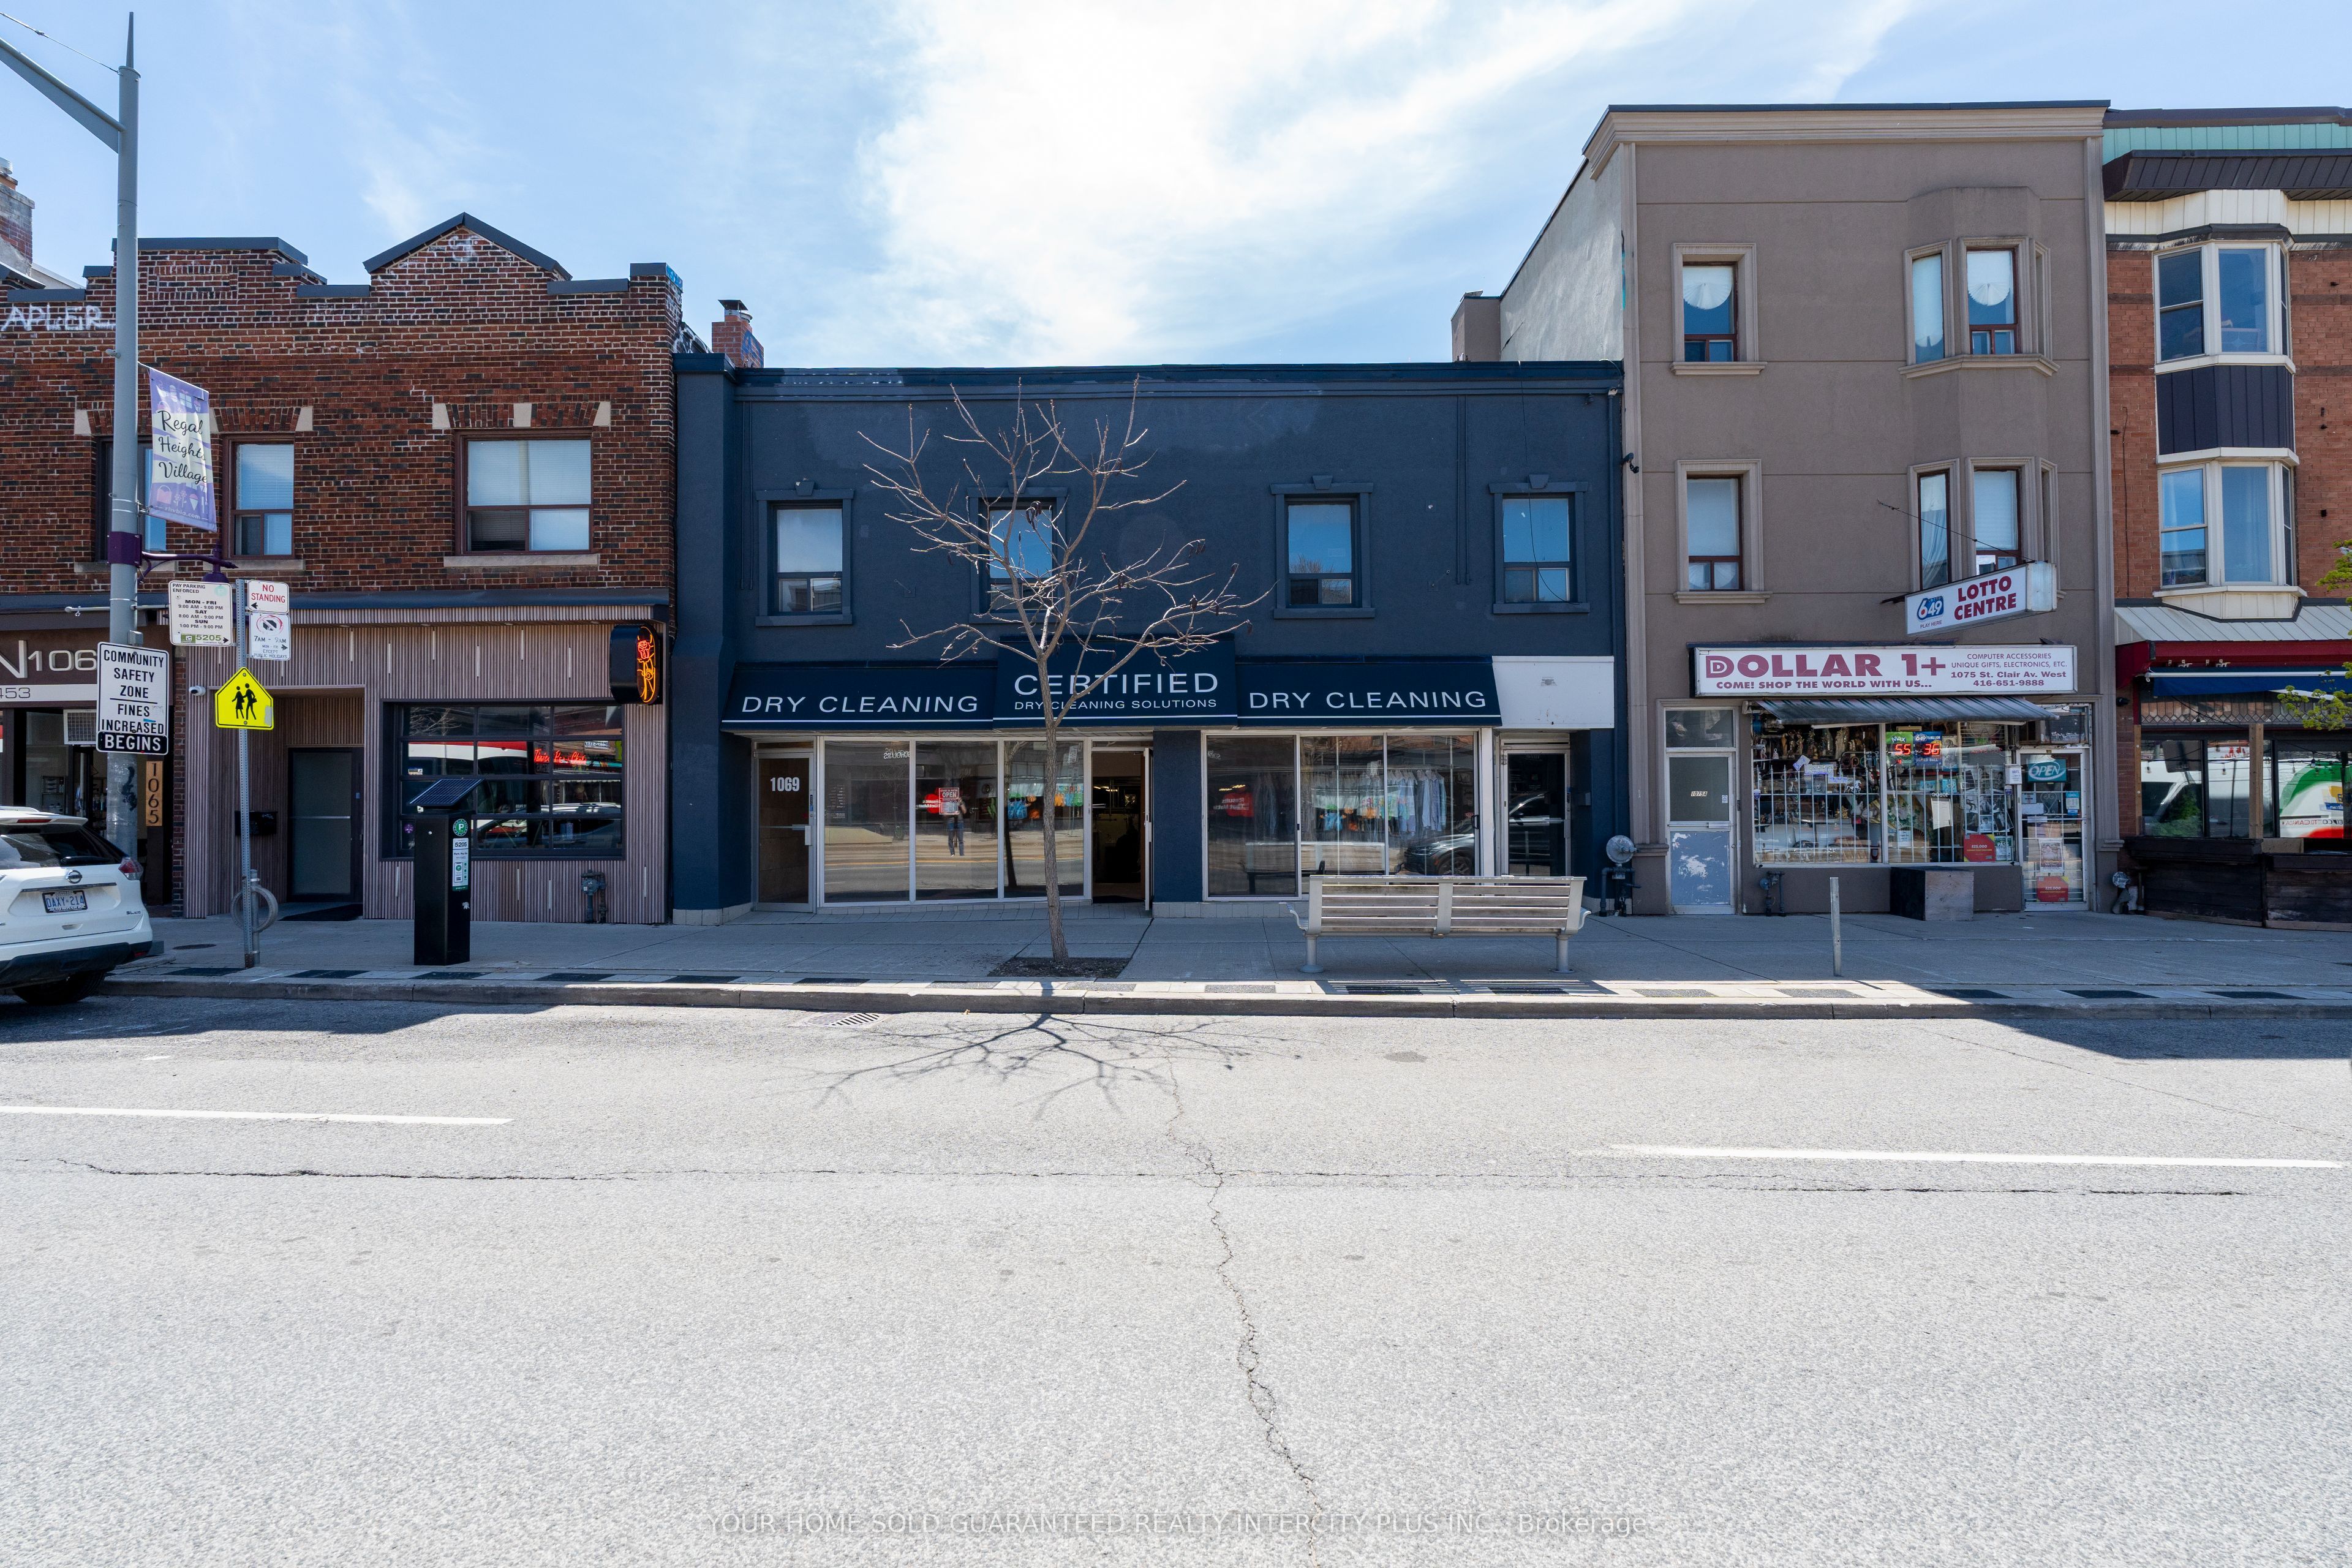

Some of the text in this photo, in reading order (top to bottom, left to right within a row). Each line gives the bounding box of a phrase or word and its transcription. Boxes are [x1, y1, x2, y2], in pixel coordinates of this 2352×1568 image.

[157, 410, 203, 435] Regal
[159, 436, 206, 461] Heights
[159, 461, 208, 484] Village
[251, 593, 285, 603] STANDING
[1958, 576, 2011, 602] LOTTO
[1918, 600, 1943, 619] 649
[1954, 593, 2016, 620] CENTRE
[104, 649, 164, 668] COMMUNITY
[1706, 654, 1946, 678] DOLLAR 1+
[114, 668, 155, 682] SAFETY
[1014, 673, 1218, 695] CERTIFIED
[120, 685, 149, 699] ZONE
[1250, 690, 1486, 709] DRY CLEANING
[118, 704, 150, 717] FINES
[742, 695, 978, 713] DRY CLEANING
[1015, 701, 1044, 710] DRY
[1131, 699, 1216, 709] SOLUTIONS
[102, 719, 164, 734] INCREASED
[105, 734, 161, 752] BEGINS
[1894, 744, 1911, 756] 55
[2029, 765, 2059, 776] OPEN
[148, 763, 159, 824] 1065
[771, 777, 800, 792] 1069
[45, 895, 85, 908] DAXY 214
